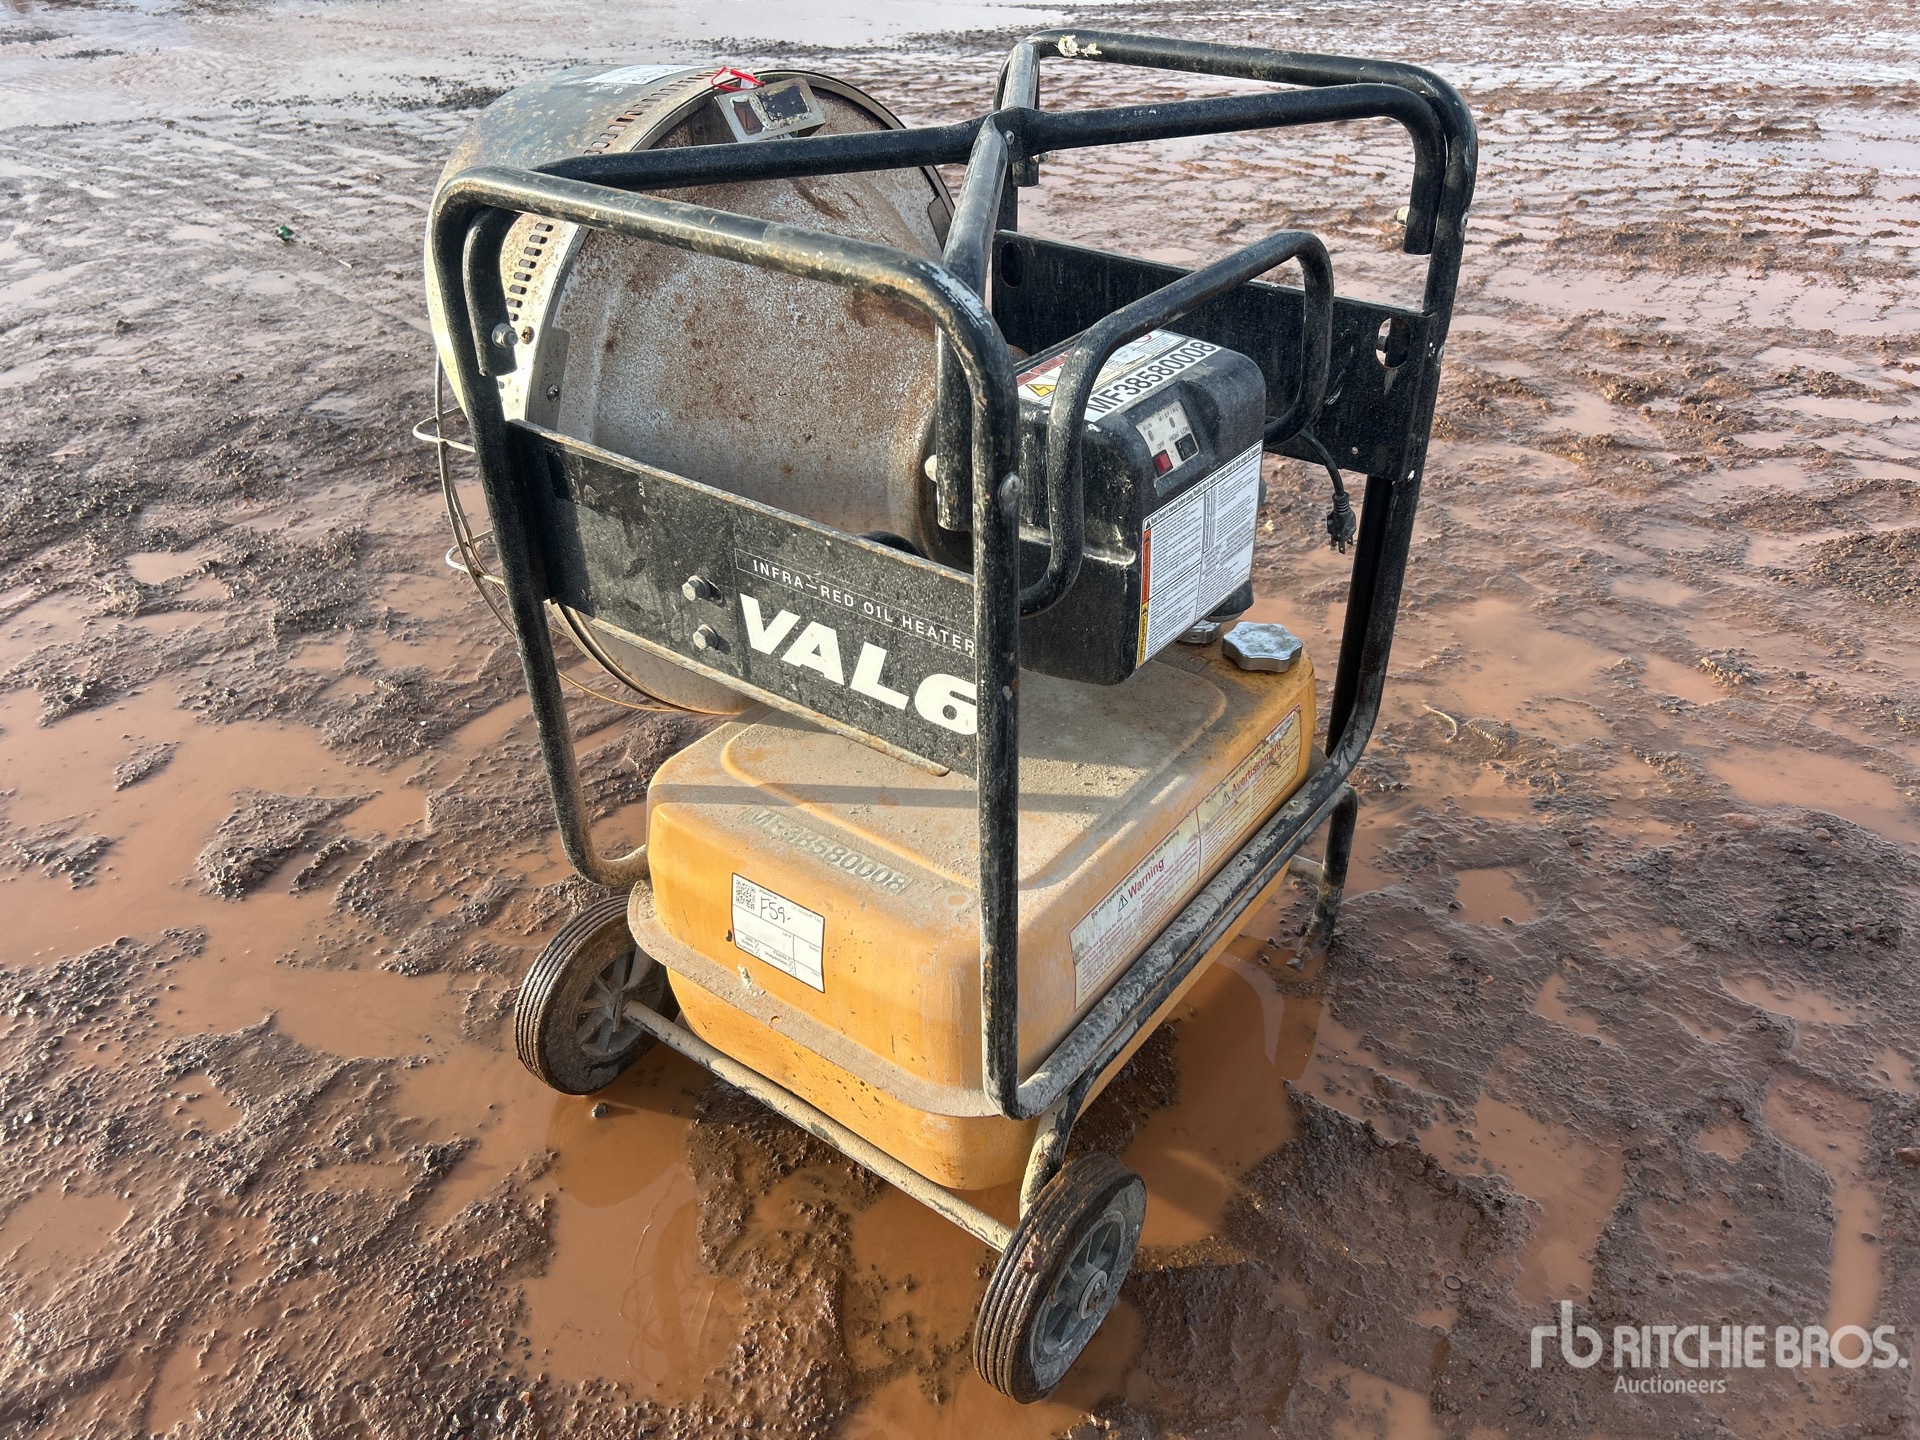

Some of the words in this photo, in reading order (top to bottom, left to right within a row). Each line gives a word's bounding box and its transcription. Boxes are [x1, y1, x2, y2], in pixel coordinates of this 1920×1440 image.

[1087, 341, 1217, 414] MF38580008
[1156, 441, 1165, 450] OFF
[752, 558, 855, 608] INFRA-RED
[863, 601, 894, 623] OIL
[902, 615, 975, 653] HEATER
[740, 593, 978, 735] VAL6
[1127, 858, 1165, 899] Warning
